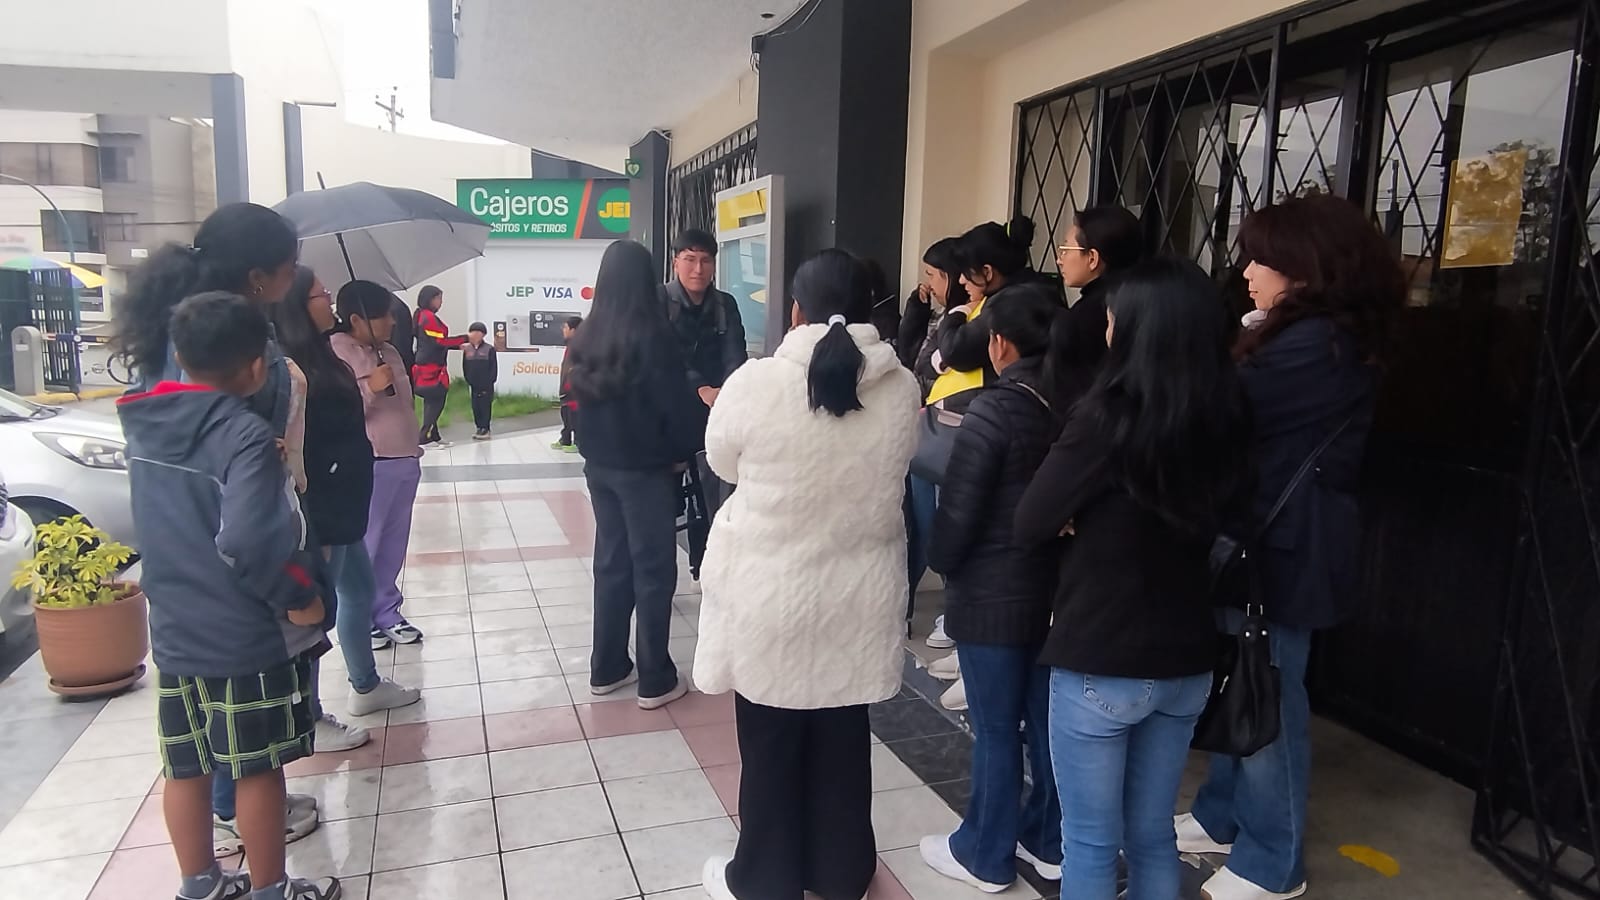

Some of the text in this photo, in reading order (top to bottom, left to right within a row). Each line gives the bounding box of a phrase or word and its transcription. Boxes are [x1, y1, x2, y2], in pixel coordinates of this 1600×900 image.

[470, 187, 569, 222] Cajeros
[523, 224, 529, 233] Y
[531, 224, 567, 233] RETIROS
[506, 286, 573, 298] JEP VISA
